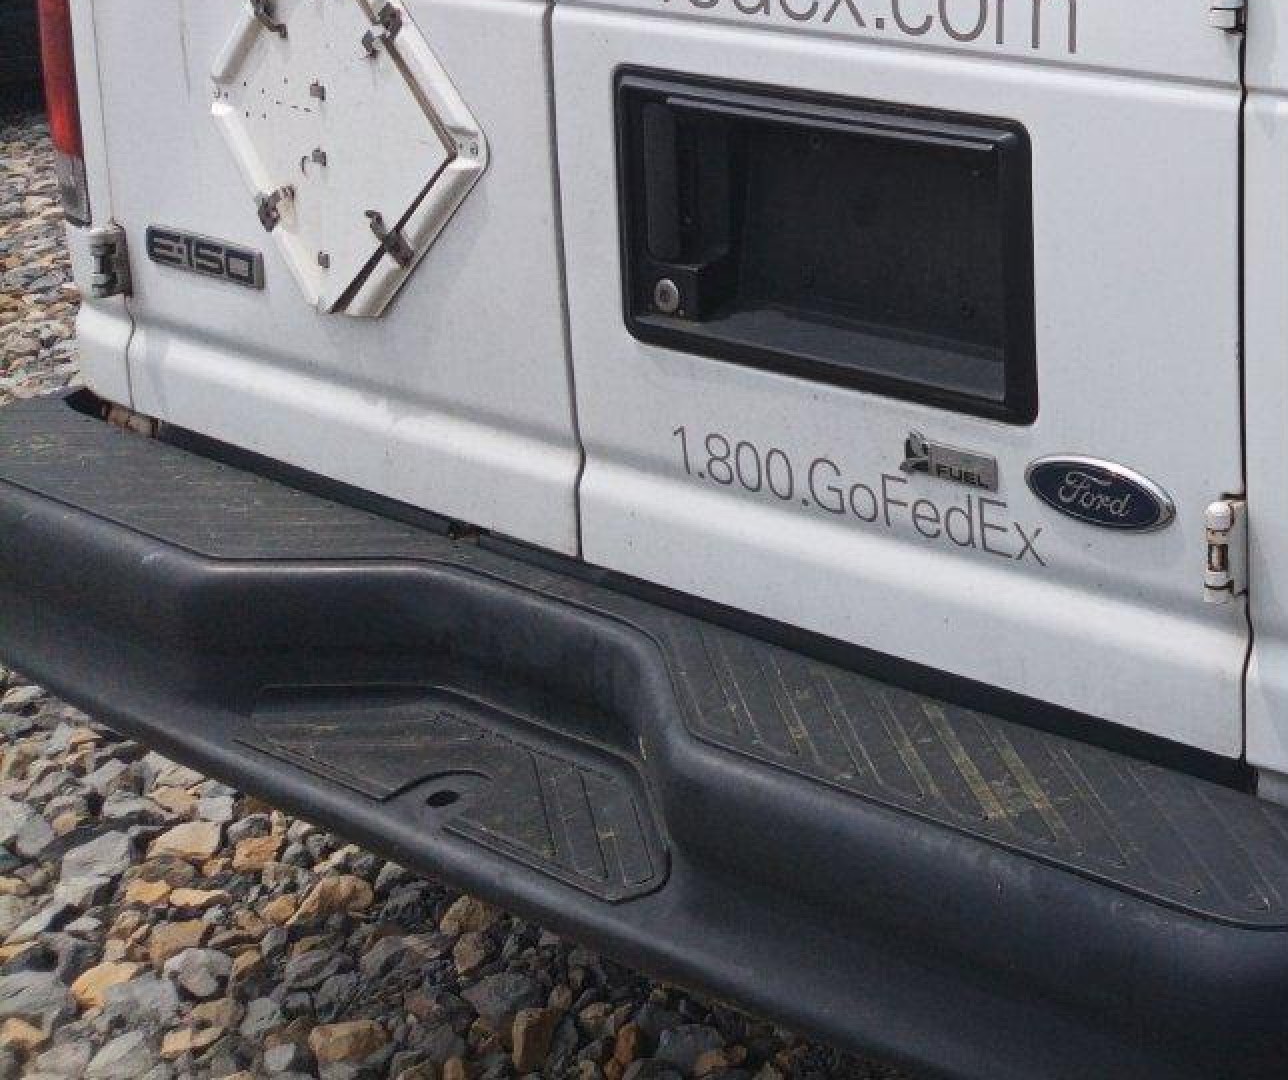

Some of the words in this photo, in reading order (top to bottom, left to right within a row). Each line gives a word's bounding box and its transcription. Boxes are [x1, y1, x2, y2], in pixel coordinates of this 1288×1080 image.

[672, 425, 1047, 566] 1.800.GoFedEx
[935, 463, 989, 489] FUEL
[1057, 471, 1132, 518] Ford
